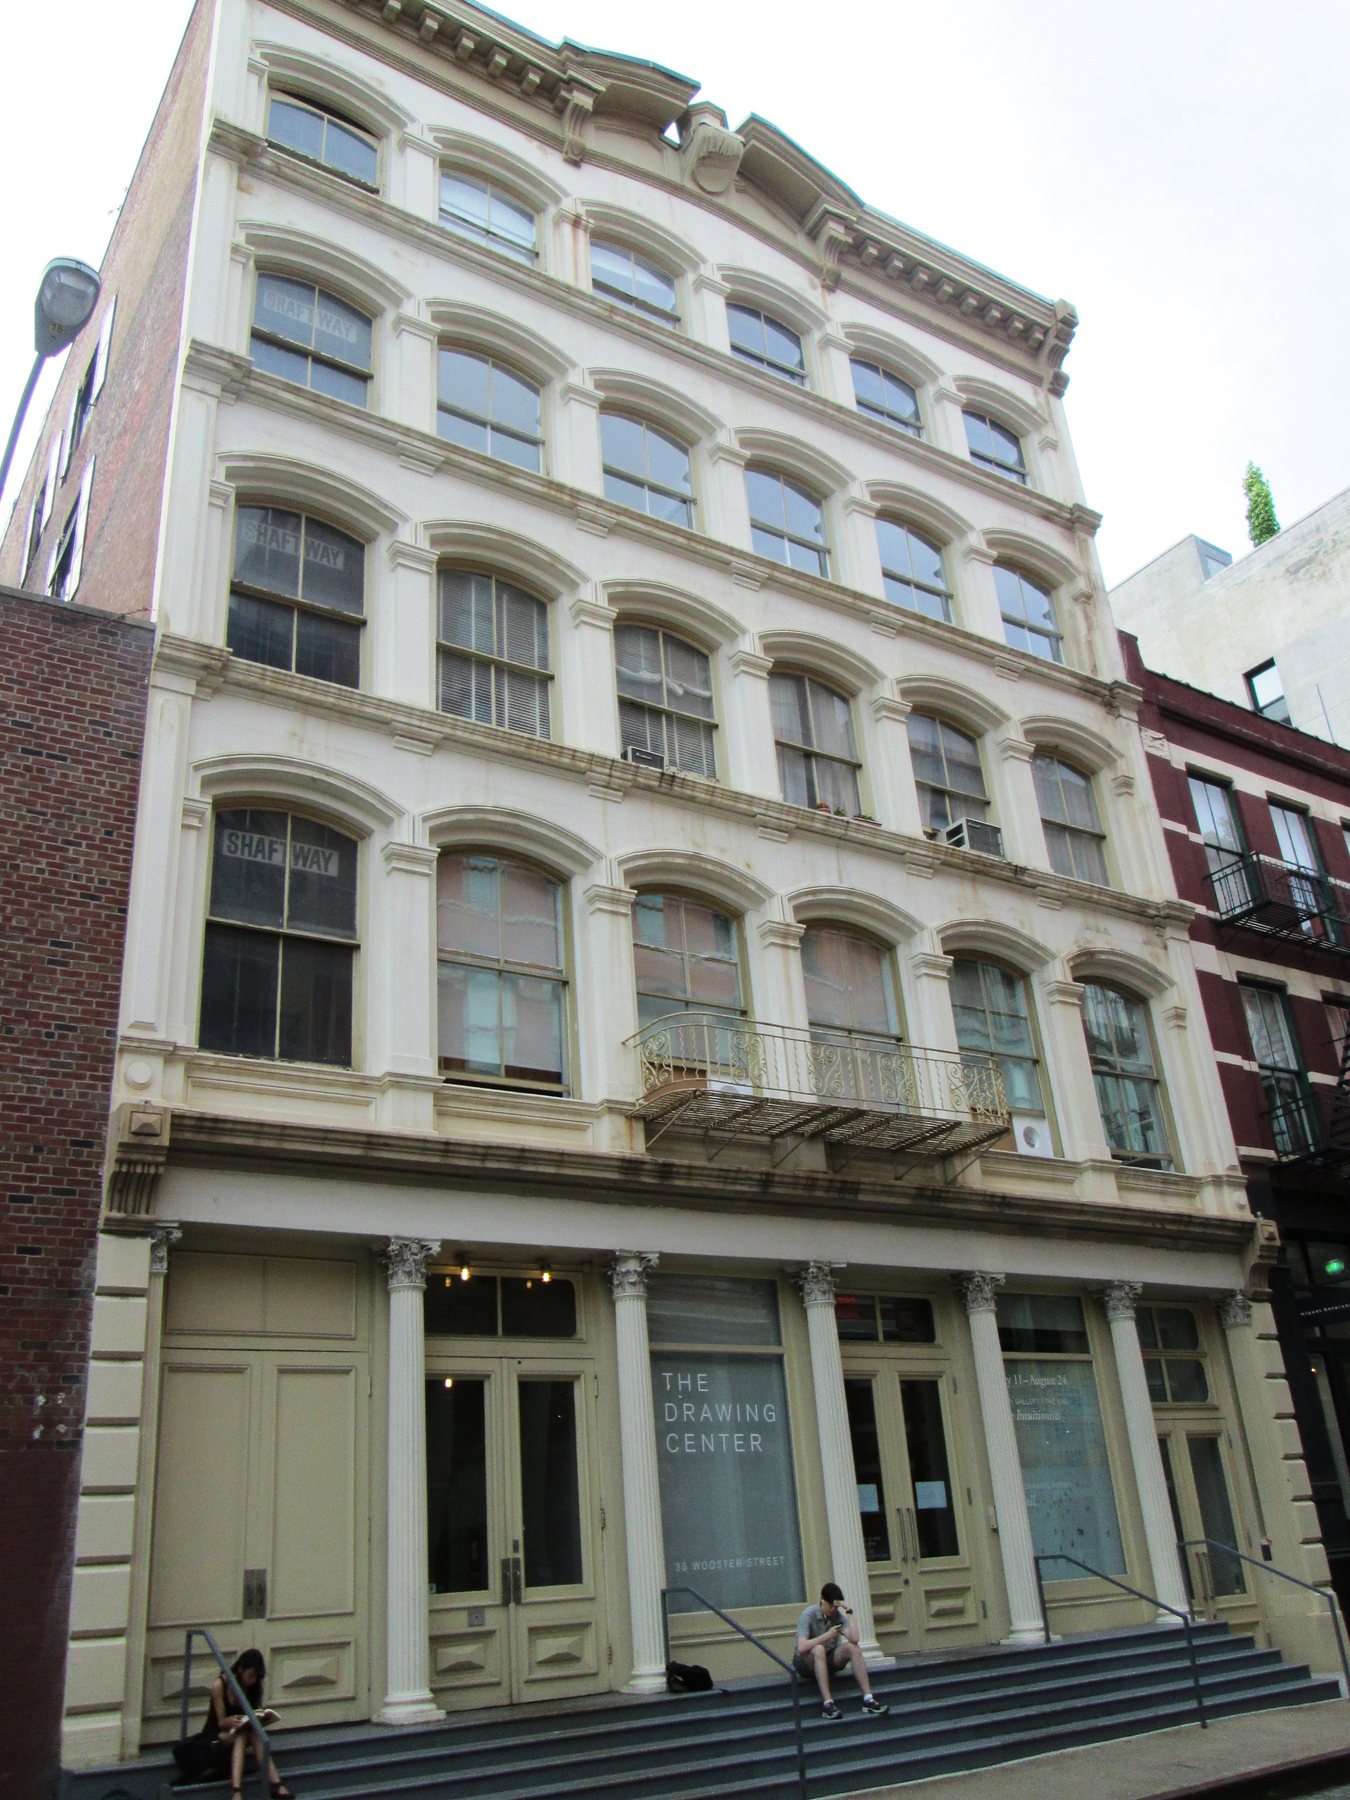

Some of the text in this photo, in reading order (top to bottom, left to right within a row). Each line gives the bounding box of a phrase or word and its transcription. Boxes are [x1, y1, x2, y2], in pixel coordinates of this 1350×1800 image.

[662, 1372, 709, 1392] THE
[664, 1403, 777, 1422] DRAWING
[666, 1433, 763, 1453] CENTER
[746, 1555, 785, 1568] STREET
